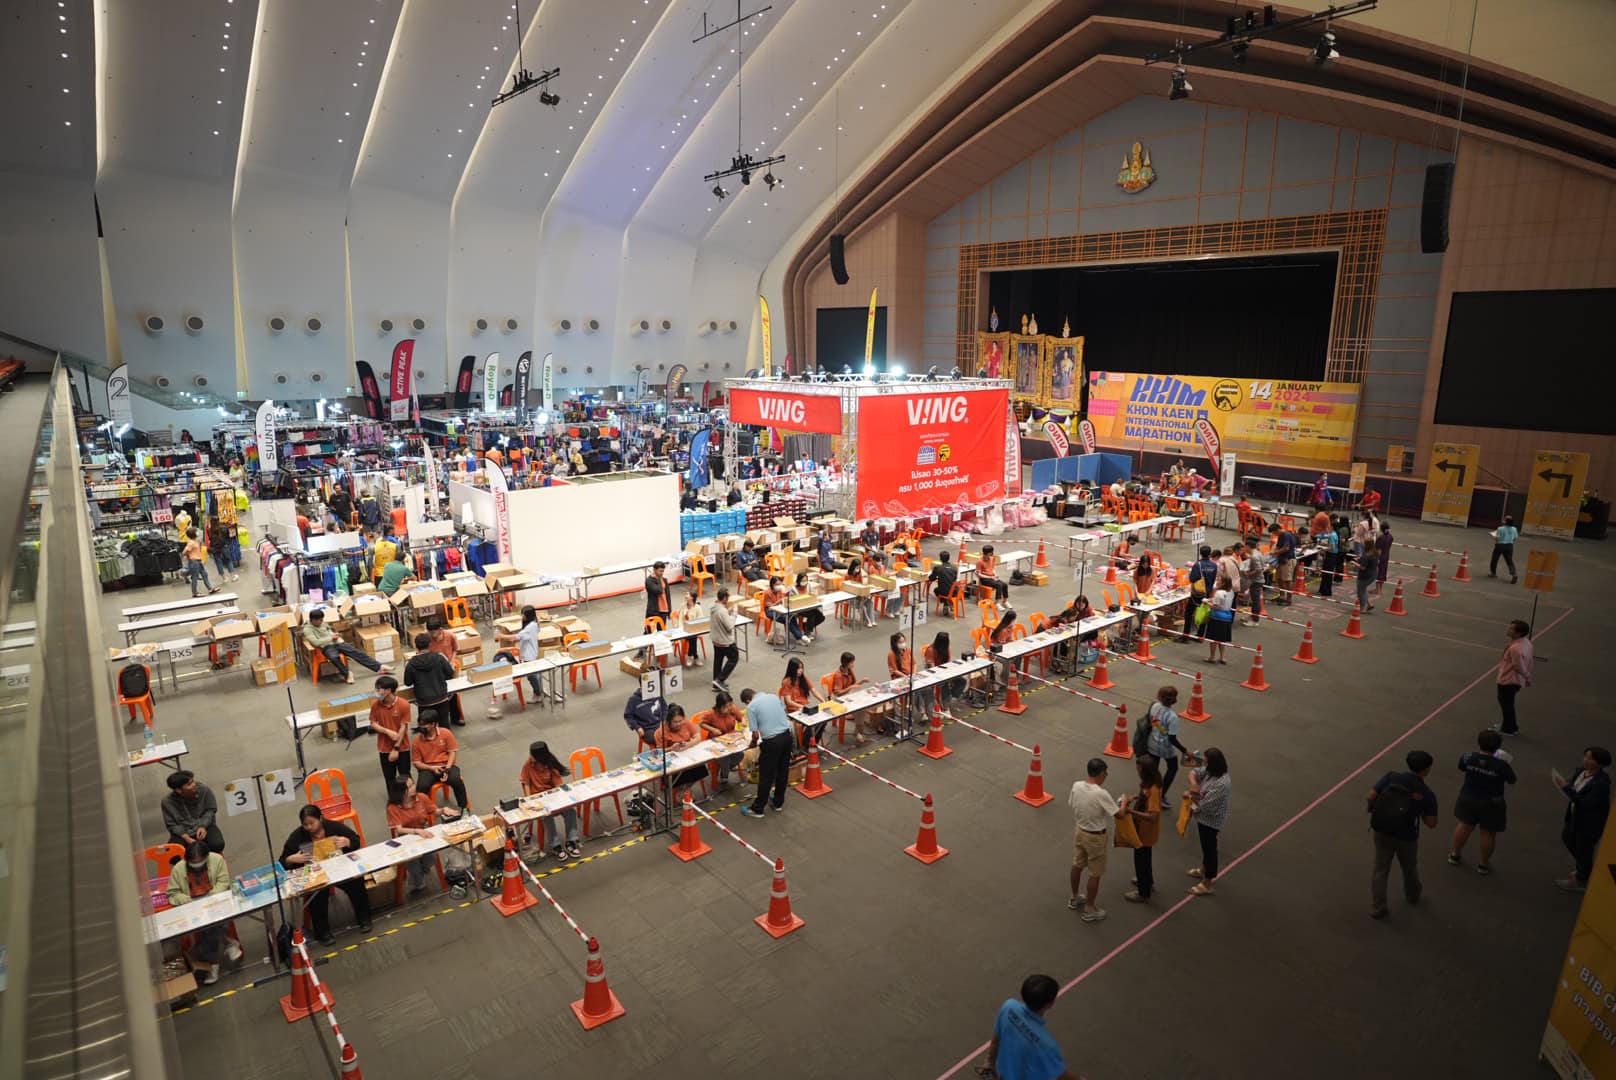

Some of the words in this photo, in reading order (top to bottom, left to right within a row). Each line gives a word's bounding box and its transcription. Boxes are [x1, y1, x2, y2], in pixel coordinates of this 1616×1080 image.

[399, 350, 408, 370] PEAK
[396, 372, 405, 396] ACTIVE
[486, 365, 496, 400] Royal-D
[1249, 381, 1273, 400] 14
[1276, 383, 1322, 392] JANUARY
[1274, 390, 1311, 401] 2024
[1127, 404, 1158, 417] KHON
[1161, 407, 1194, 419] KAEN
[1126, 416, 1192, 431] INTERNATIONAL
[264, 413, 275, 460] SUUNTO
[1124, 426, 1192, 443] MARATHON
[903, 614, 909, 625] 7
[918, 610, 924, 620] 8
[170, 648, 193, 660] 3XS
[647, 680, 656, 693] 5
[670, 675, 678, 688] 6
[273, 780, 287, 796] 4
[234, 790, 248, 806] 3
[1580, 969, 1603, 996] BIB
